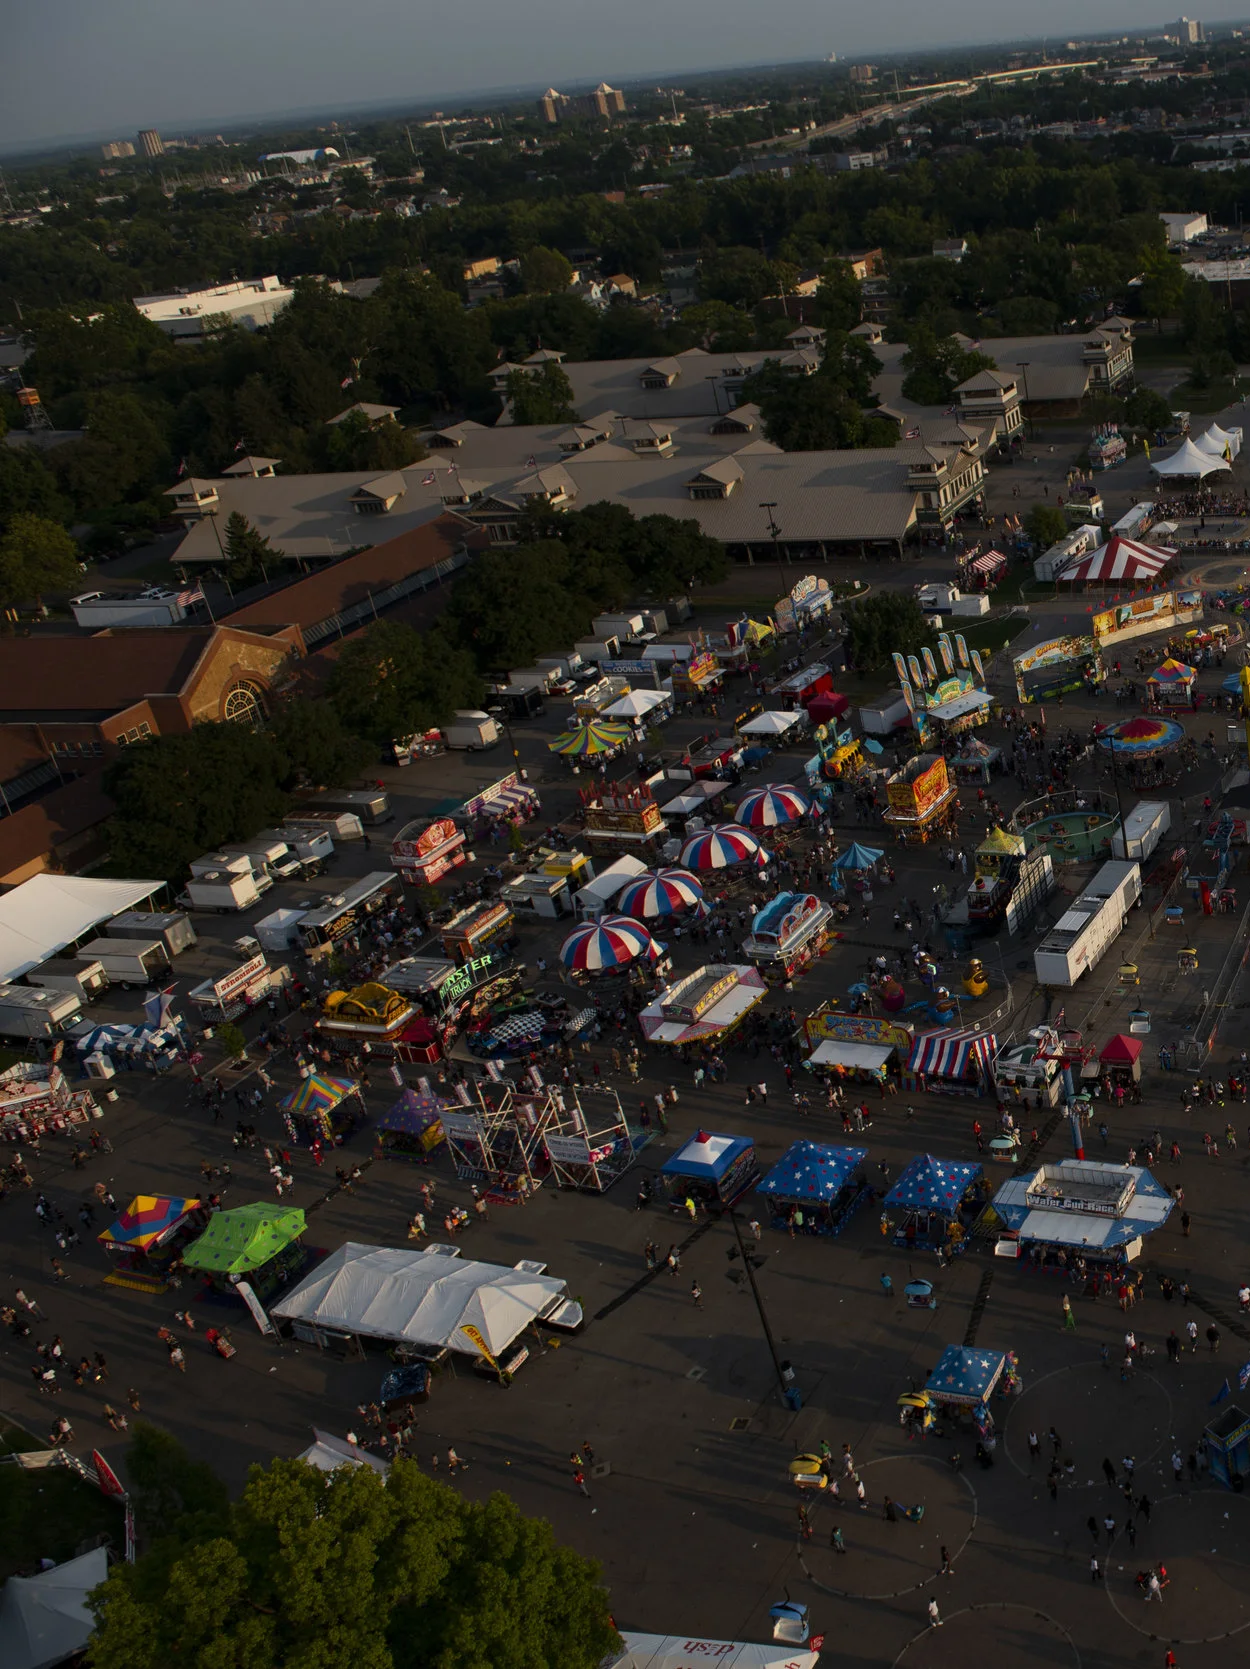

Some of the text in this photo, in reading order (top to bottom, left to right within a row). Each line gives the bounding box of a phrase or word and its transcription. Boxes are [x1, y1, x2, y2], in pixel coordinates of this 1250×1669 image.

[612, 665, 643, 673] COOKIES
[220, 959, 263, 991] STROMBOLI
[449, 975, 473, 999] TRUCK
[695, 973, 737, 1014] WATER
[388, 1004, 406, 1021] FRIES
[826, 1014, 883, 1032] SHOOT
[1028, 1195, 1114, 1213] Water Gun Race
[683, 1641, 735, 1656] dish
